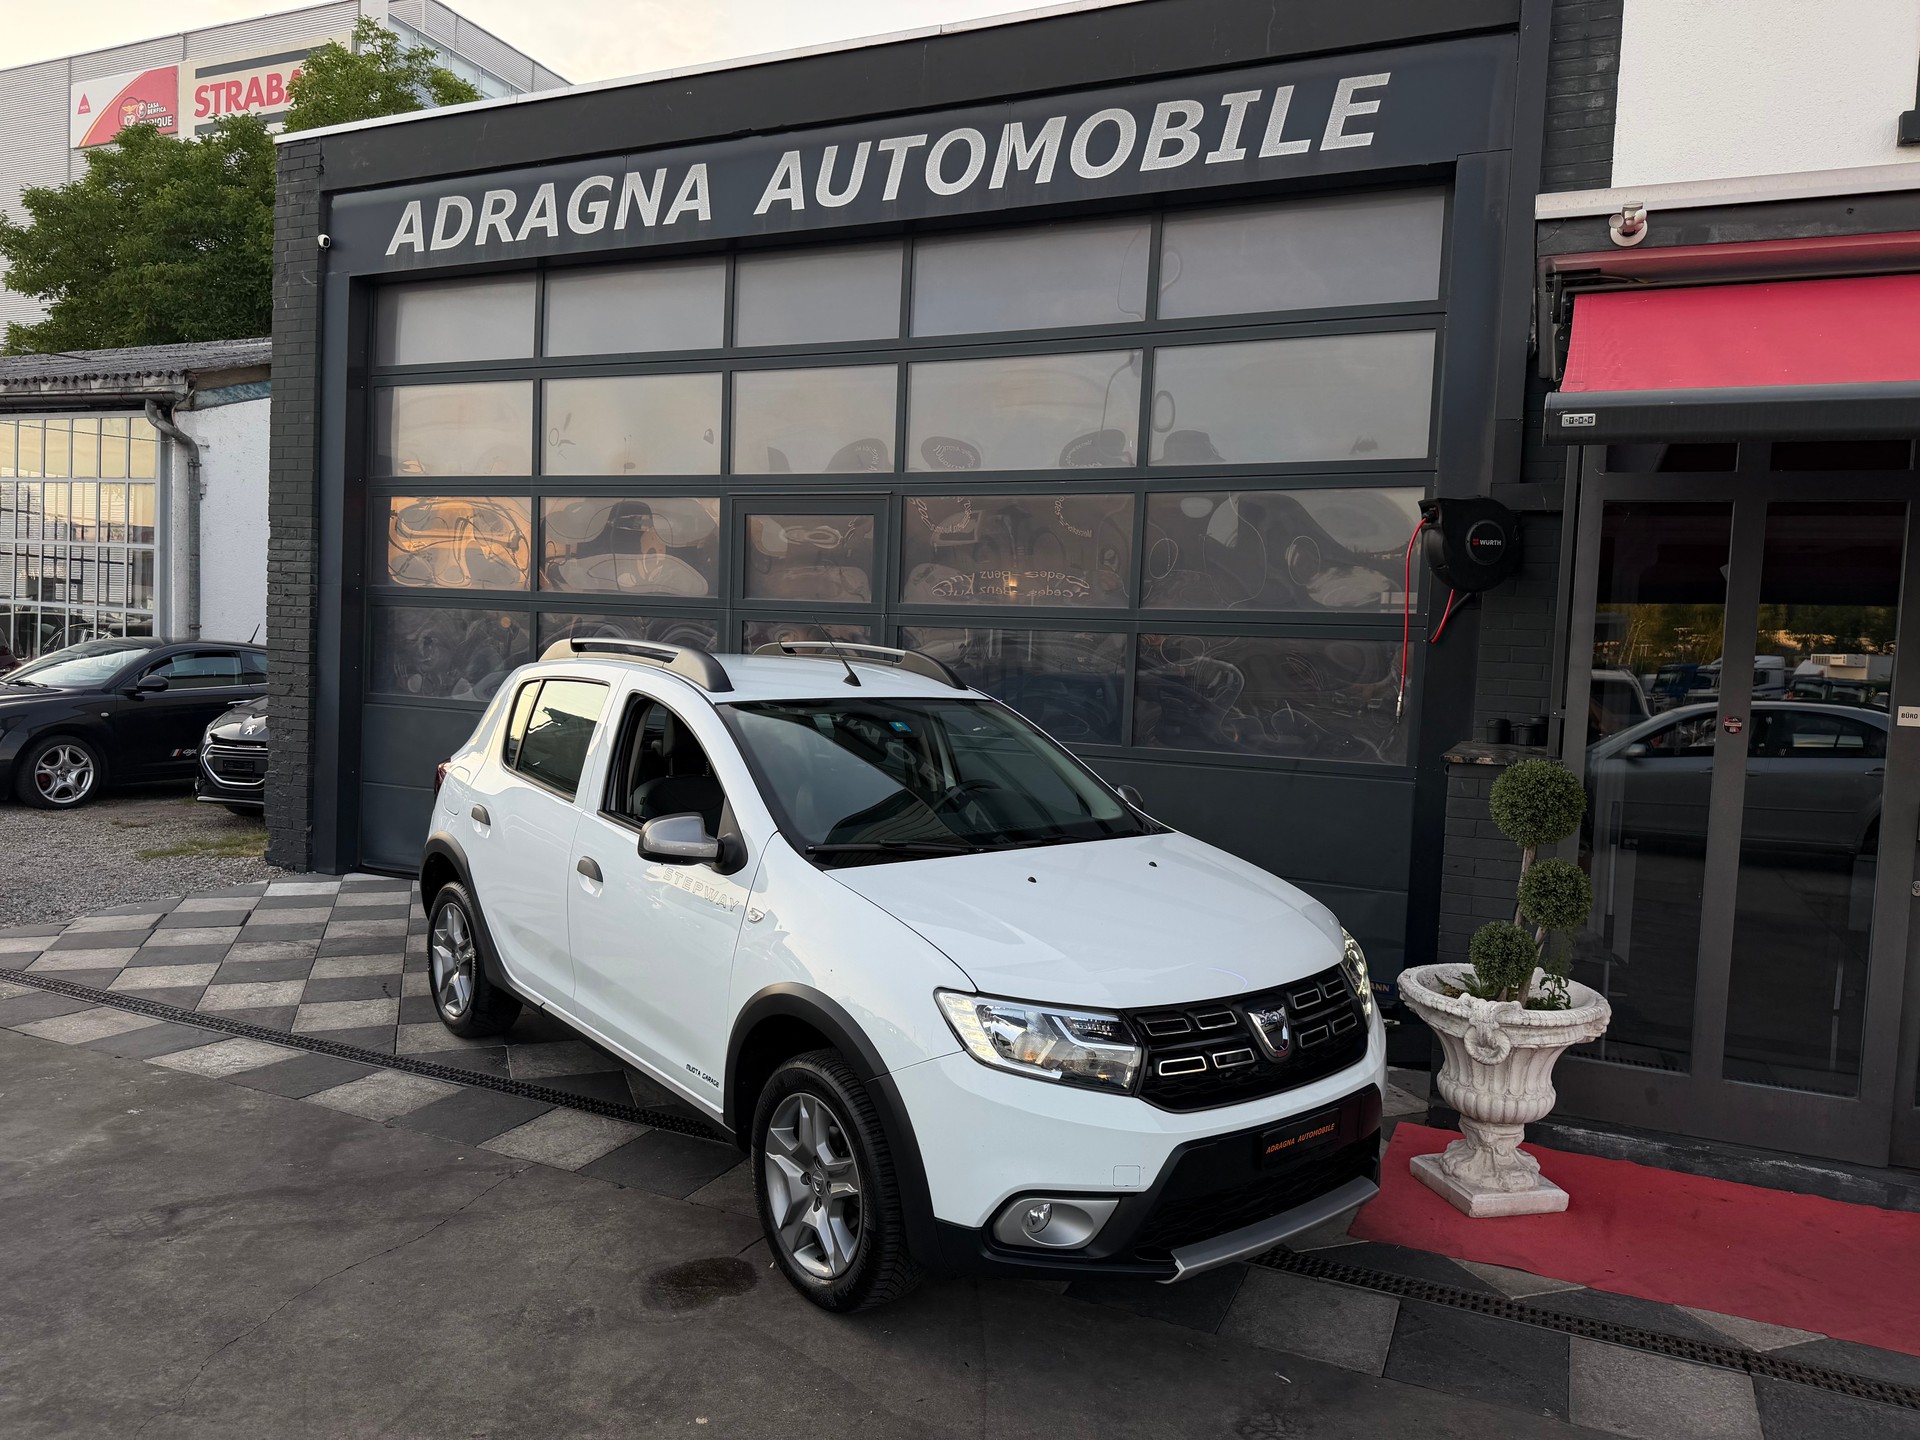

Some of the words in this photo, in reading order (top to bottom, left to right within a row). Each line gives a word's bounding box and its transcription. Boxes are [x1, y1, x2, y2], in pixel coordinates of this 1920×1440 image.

[139, 115, 173, 128] IQUE
[147, 107, 167, 115] BENFICA
[385, 162, 712, 257] ADRAGNA
[753, 72, 1392, 216] AUTOMOBILE
[1901, 711, 1919, 720] BÜRO
[662, 867, 740, 912] STEPWAY
[1265, 1137, 1295, 1155] ADRAGNA
[1298, 1123, 1335, 1143] AUTOMOBILE
